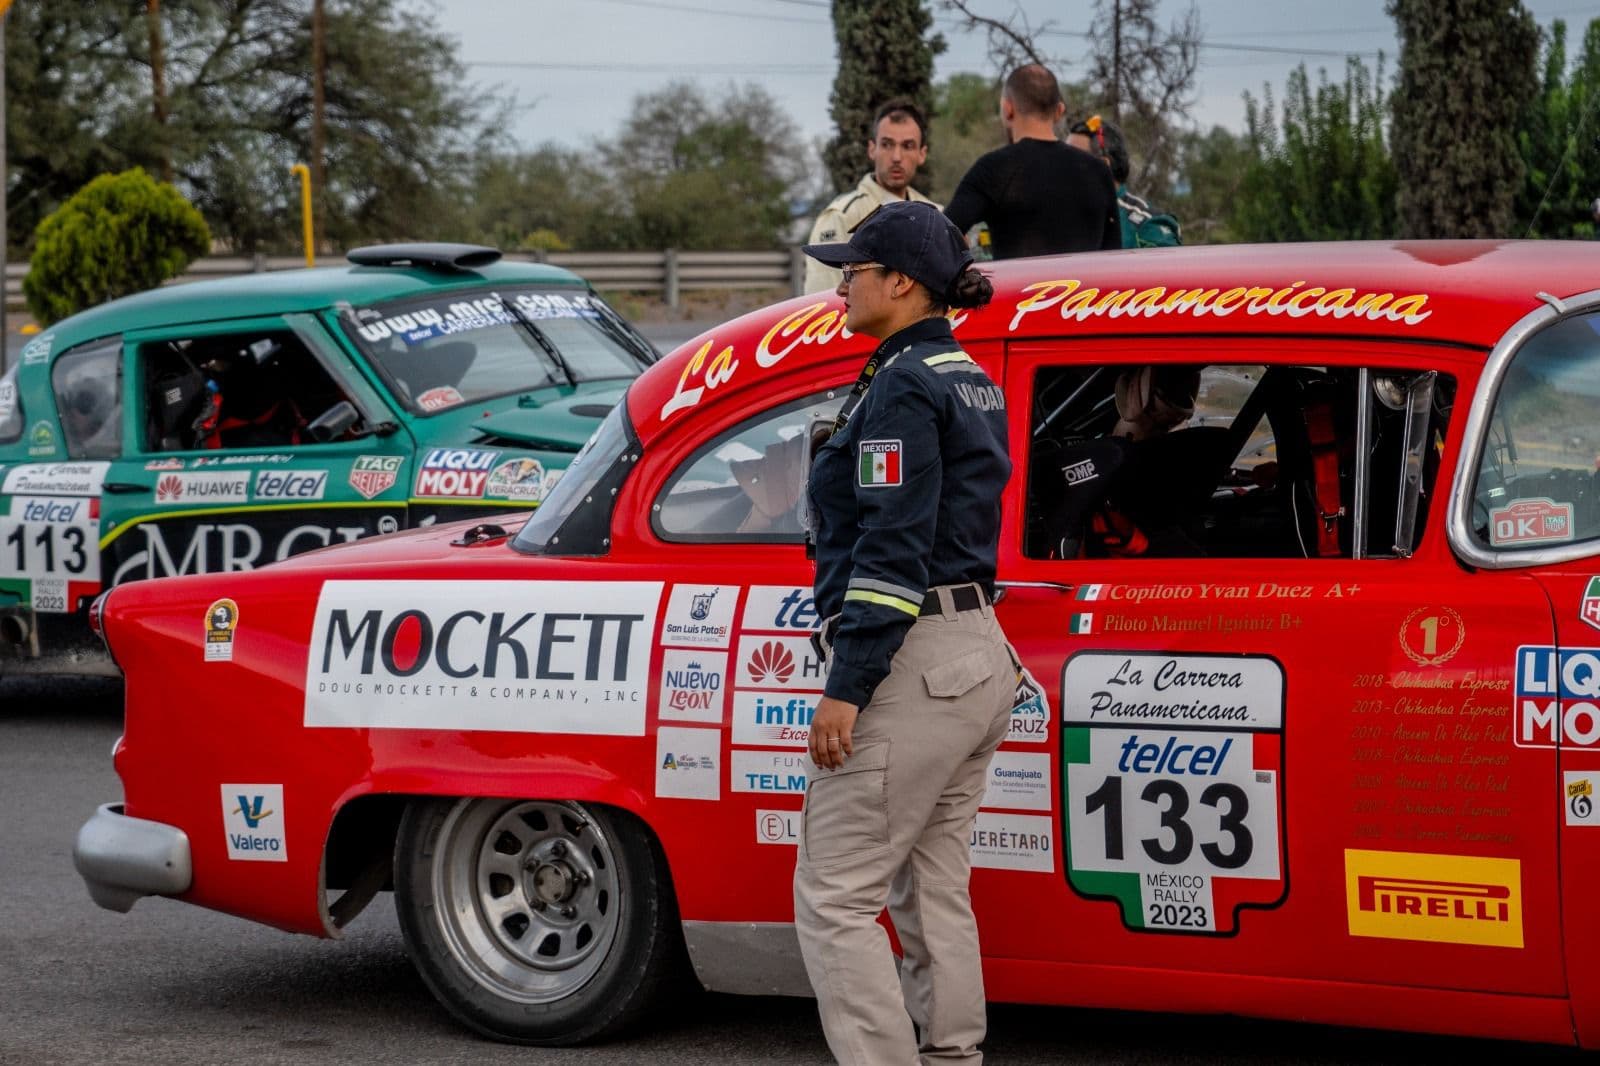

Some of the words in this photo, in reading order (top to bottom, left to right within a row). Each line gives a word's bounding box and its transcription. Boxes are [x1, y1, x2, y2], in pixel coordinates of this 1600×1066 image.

[661, 339, 740, 421] La
[1009, 279, 1433, 331] Panamericana
[863, 443, 898, 453] MÉXICO
[361, 457, 400, 470] TAG
[424, 450, 492, 470] LIQUI
[1065, 462, 1096, 481] OMP
[187, 481, 248, 496] HUAWEI
[255, 471, 327, 497] telcel
[352, 472, 395, 494] HEUER
[418, 472, 487, 496] MOLY
[489, 485, 537, 495] VERACRUZ
[24, 500, 80, 522] telcel
[1496, 517, 1538, 539] OK
[7, 523, 87, 573] 113
[35, 596, 64, 610] 2023
[1110, 584, 1193, 604] Copiloto
[1199, 583, 1249, 599] Yvan
[1256, 583, 1313, 599] Duez
[1324, 583, 1362, 598] A+
[667, 624, 682, 633] San
[683, 624, 700, 634] Luis
[1104, 615, 1147, 631] Piloto
[1151, 615, 1213, 632] Manuel
[321, 609, 645, 682] MOCKETT
[1107, 658, 1145, 686] La
[1153, 660, 1243, 691] Carrera
[1353, 674, 1384, 688] 2018
[1392, 671, 1454, 689] Chihuahua
[1460, 672, 1510, 696] Express
[319, 682, 363, 695] DOUG
[374, 684, 459, 697] MOCKETT
[470, 686, 478, 697] &
[605, 690, 639, 702] INC
[1090, 691, 1250, 721] Panamericana
[1394, 697, 1454, 715] Chihuahua
[1460, 698, 1510, 720] Express
[1009, 719, 1045, 733] RUZ
[1118, 735, 1234, 776] telcel
[994, 767, 1042, 780] Guanajuato
[1568, 780, 1587, 796] Canal
[1571, 794, 1593, 819] 6
[1085, 776, 1254, 869] 133
[230, 833, 280, 851] Valero
[1147, 871, 1204, 889] MÉXICO
[1154, 889, 1198, 903] RALLY
[1358, 875, 1511, 922] PIRELLI
[1149, 904, 1208, 927] 2023
